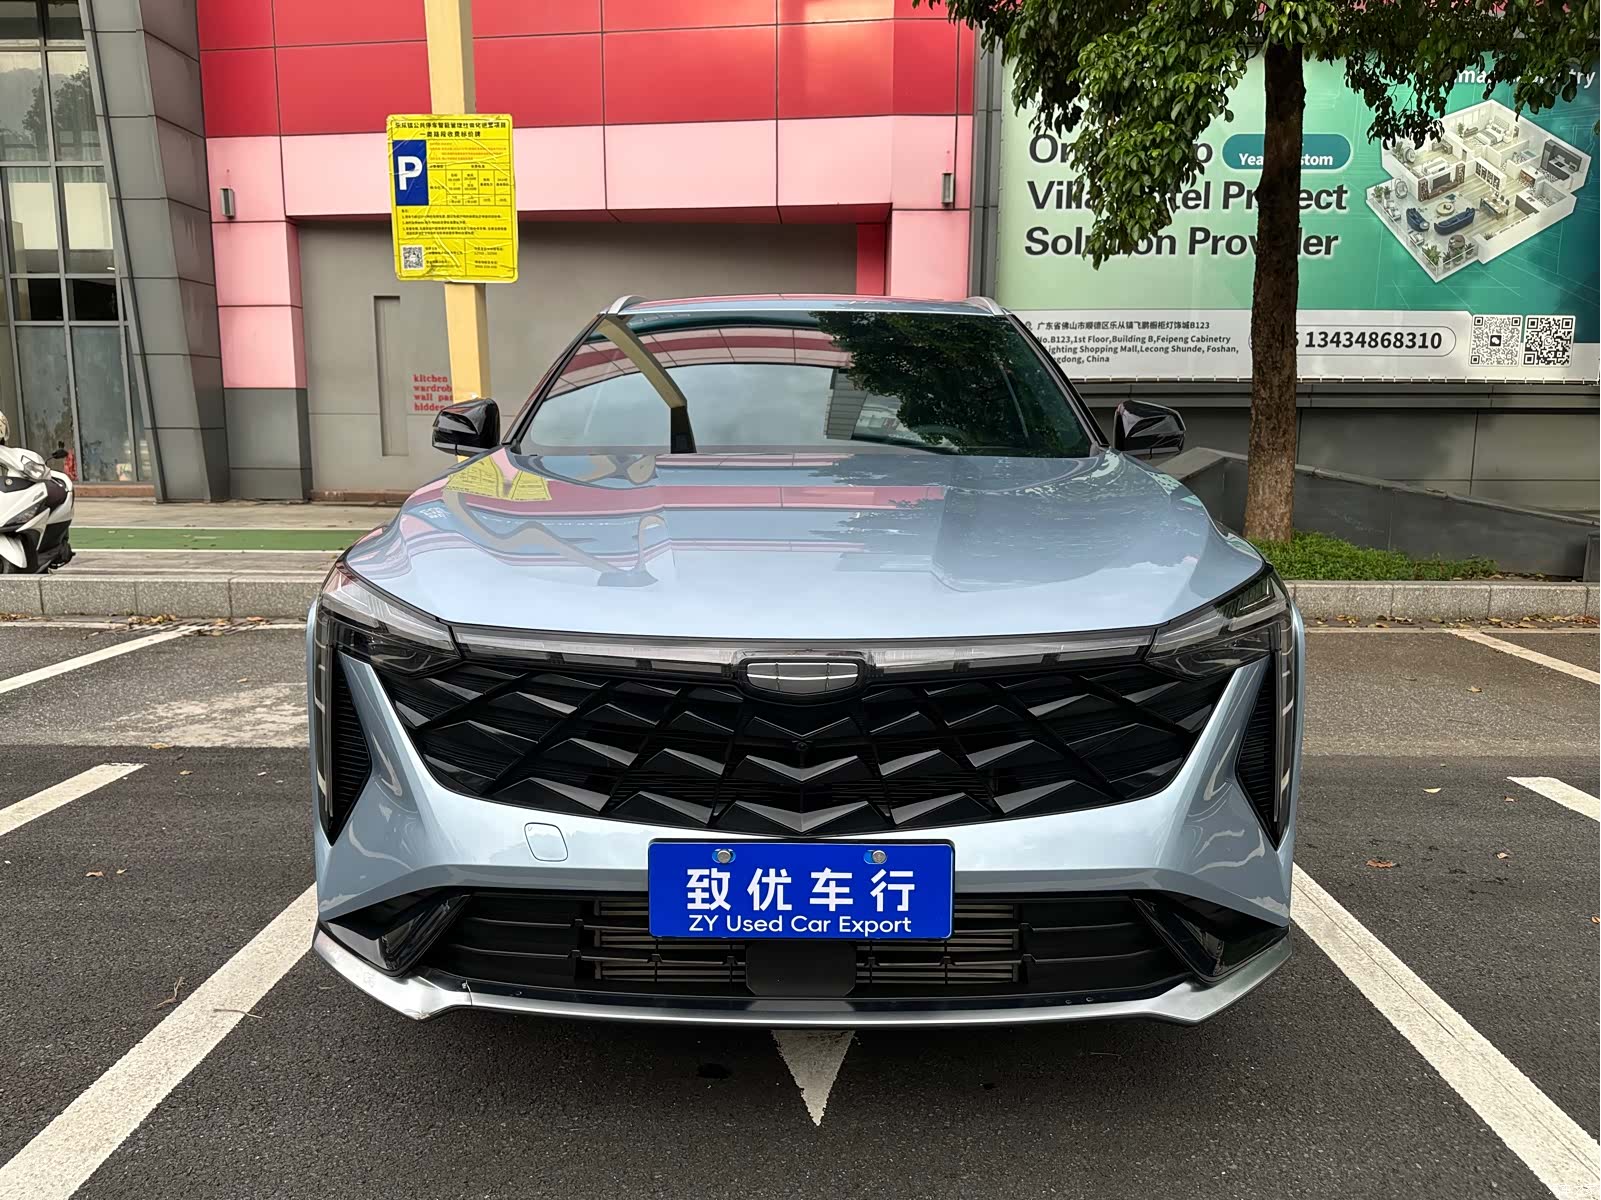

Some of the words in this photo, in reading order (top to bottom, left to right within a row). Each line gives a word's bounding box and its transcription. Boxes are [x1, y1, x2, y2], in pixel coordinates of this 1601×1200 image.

[1239, 153, 1264, 166] Yea
[1300, 153, 1333, 166] stom
[397, 156, 423, 190] P
[1222, 181, 1348, 210] Prect
[1025, 226, 1177, 256] Solon
[1087, 335, 1146, 345] Floor,Building
[1148, 335, 1189, 345] B,Feipeng
[1190, 335, 1231, 345] Cabinetry
[1305, 331, 1442, 349] 13434868310
[1047, 345, 1078, 354] ighting
[1079, 345, 1119, 354] Shopping
[1120, 344, 1170, 354] Mall,Lecong
[1170, 345, 1205, 354] Shunde,
[1206, 345, 1239, 354] Foshan,
[1055, 355, 1085, 364] gdong,
[1086, 355, 1110, 363] China
[413, 374, 448, 382] kitchen
[413, 384, 452, 392] wardrob
[413, 393, 433, 401] wall
[686, 867, 915, 912] 致优车行
[688, 915, 718, 932] ZY
[726, 915, 783, 932] Used
[791, 915, 831, 932] Car
[839, 916, 912, 937] Export
